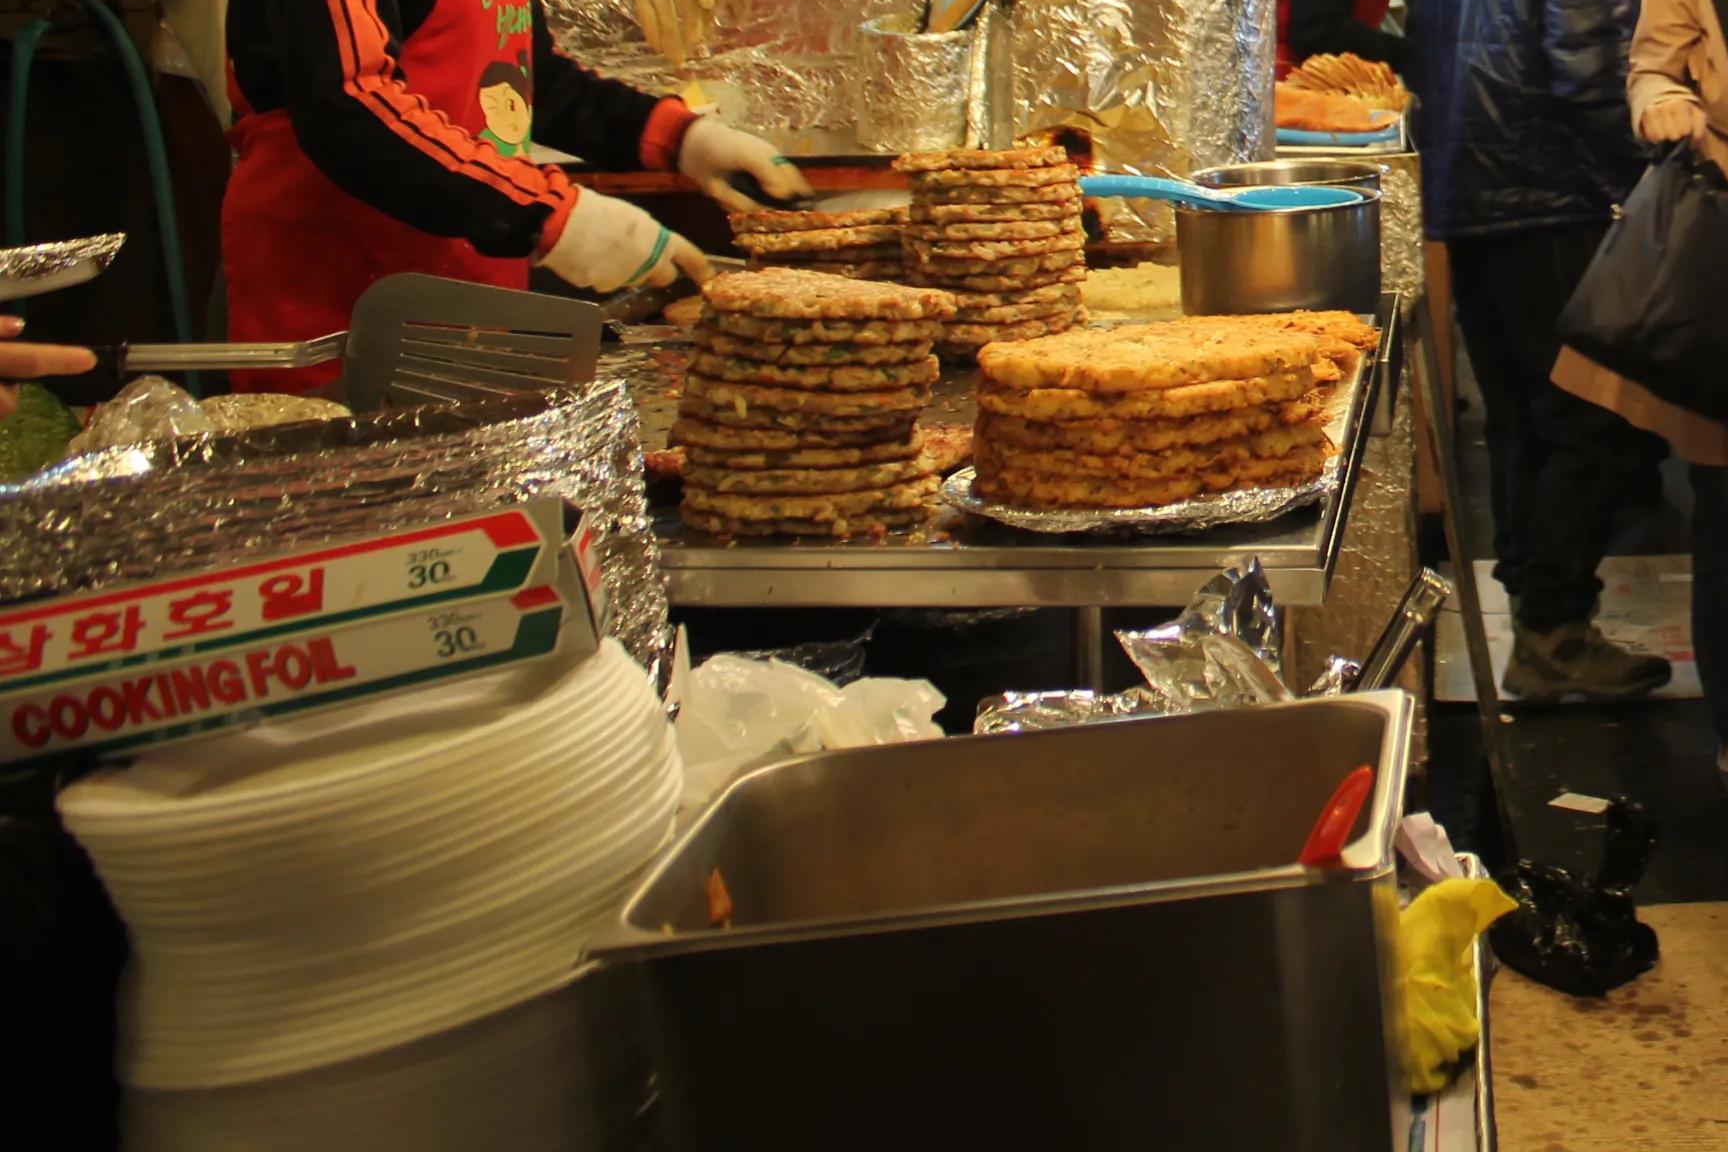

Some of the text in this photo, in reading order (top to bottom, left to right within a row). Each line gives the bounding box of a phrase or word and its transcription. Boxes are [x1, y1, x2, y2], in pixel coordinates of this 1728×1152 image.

[408, 560, 450, 590] 30
[434, 625, 477, 658] 30
[12, 637, 357, 748] COOKING FOIL
